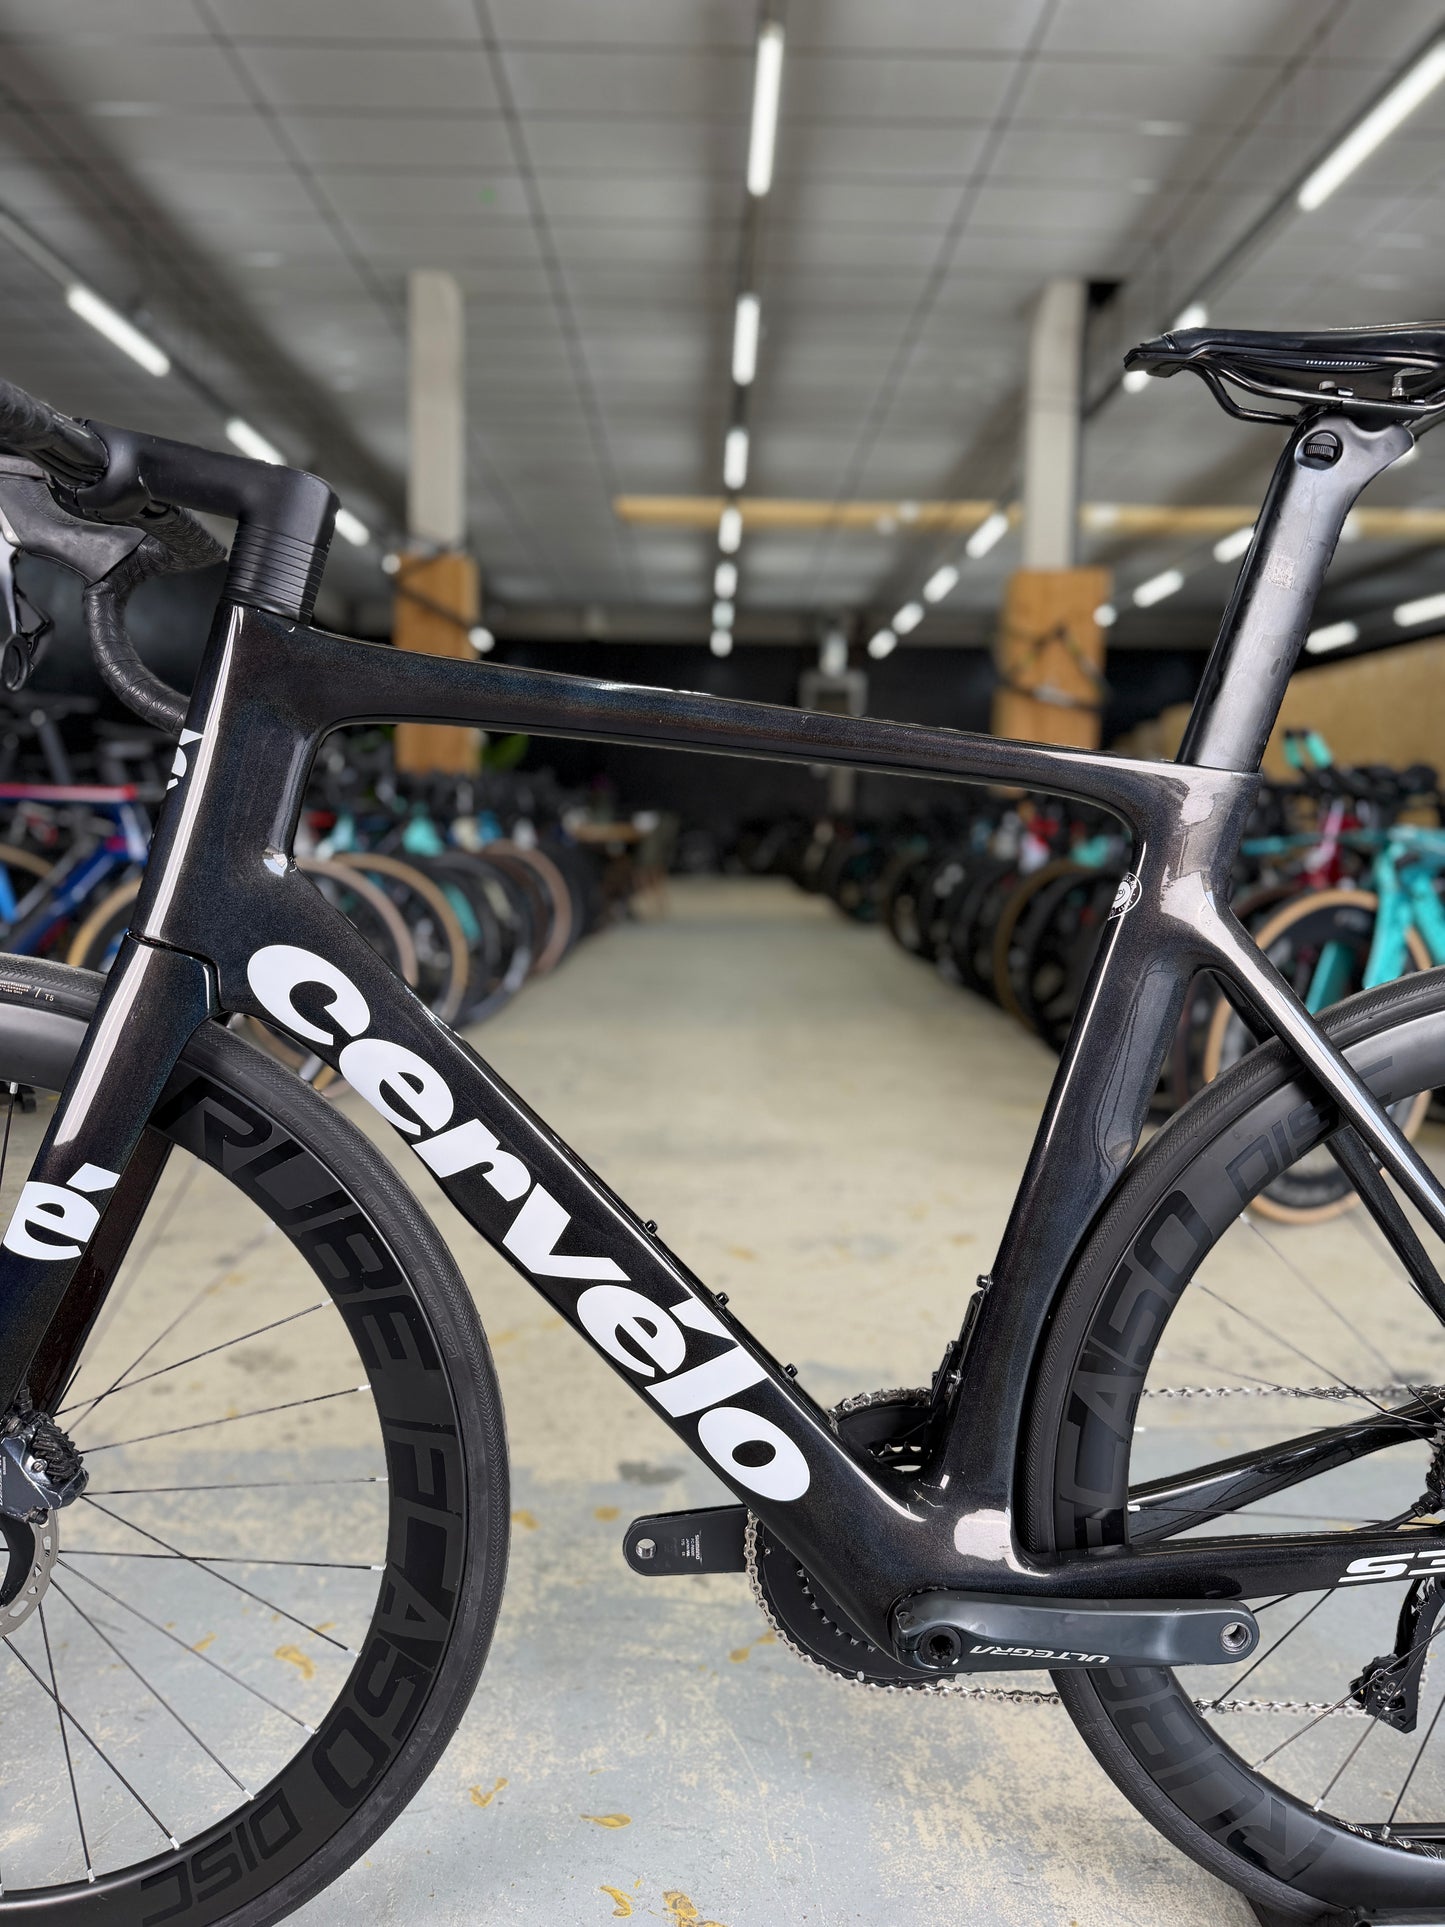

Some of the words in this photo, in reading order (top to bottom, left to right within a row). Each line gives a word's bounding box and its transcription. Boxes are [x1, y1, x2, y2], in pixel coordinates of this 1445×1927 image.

[247, 944, 811, 1502] cervélo
[969, 1645, 1111, 1664] ULTEGRA
[141, 1784, 303, 1927] DISC
